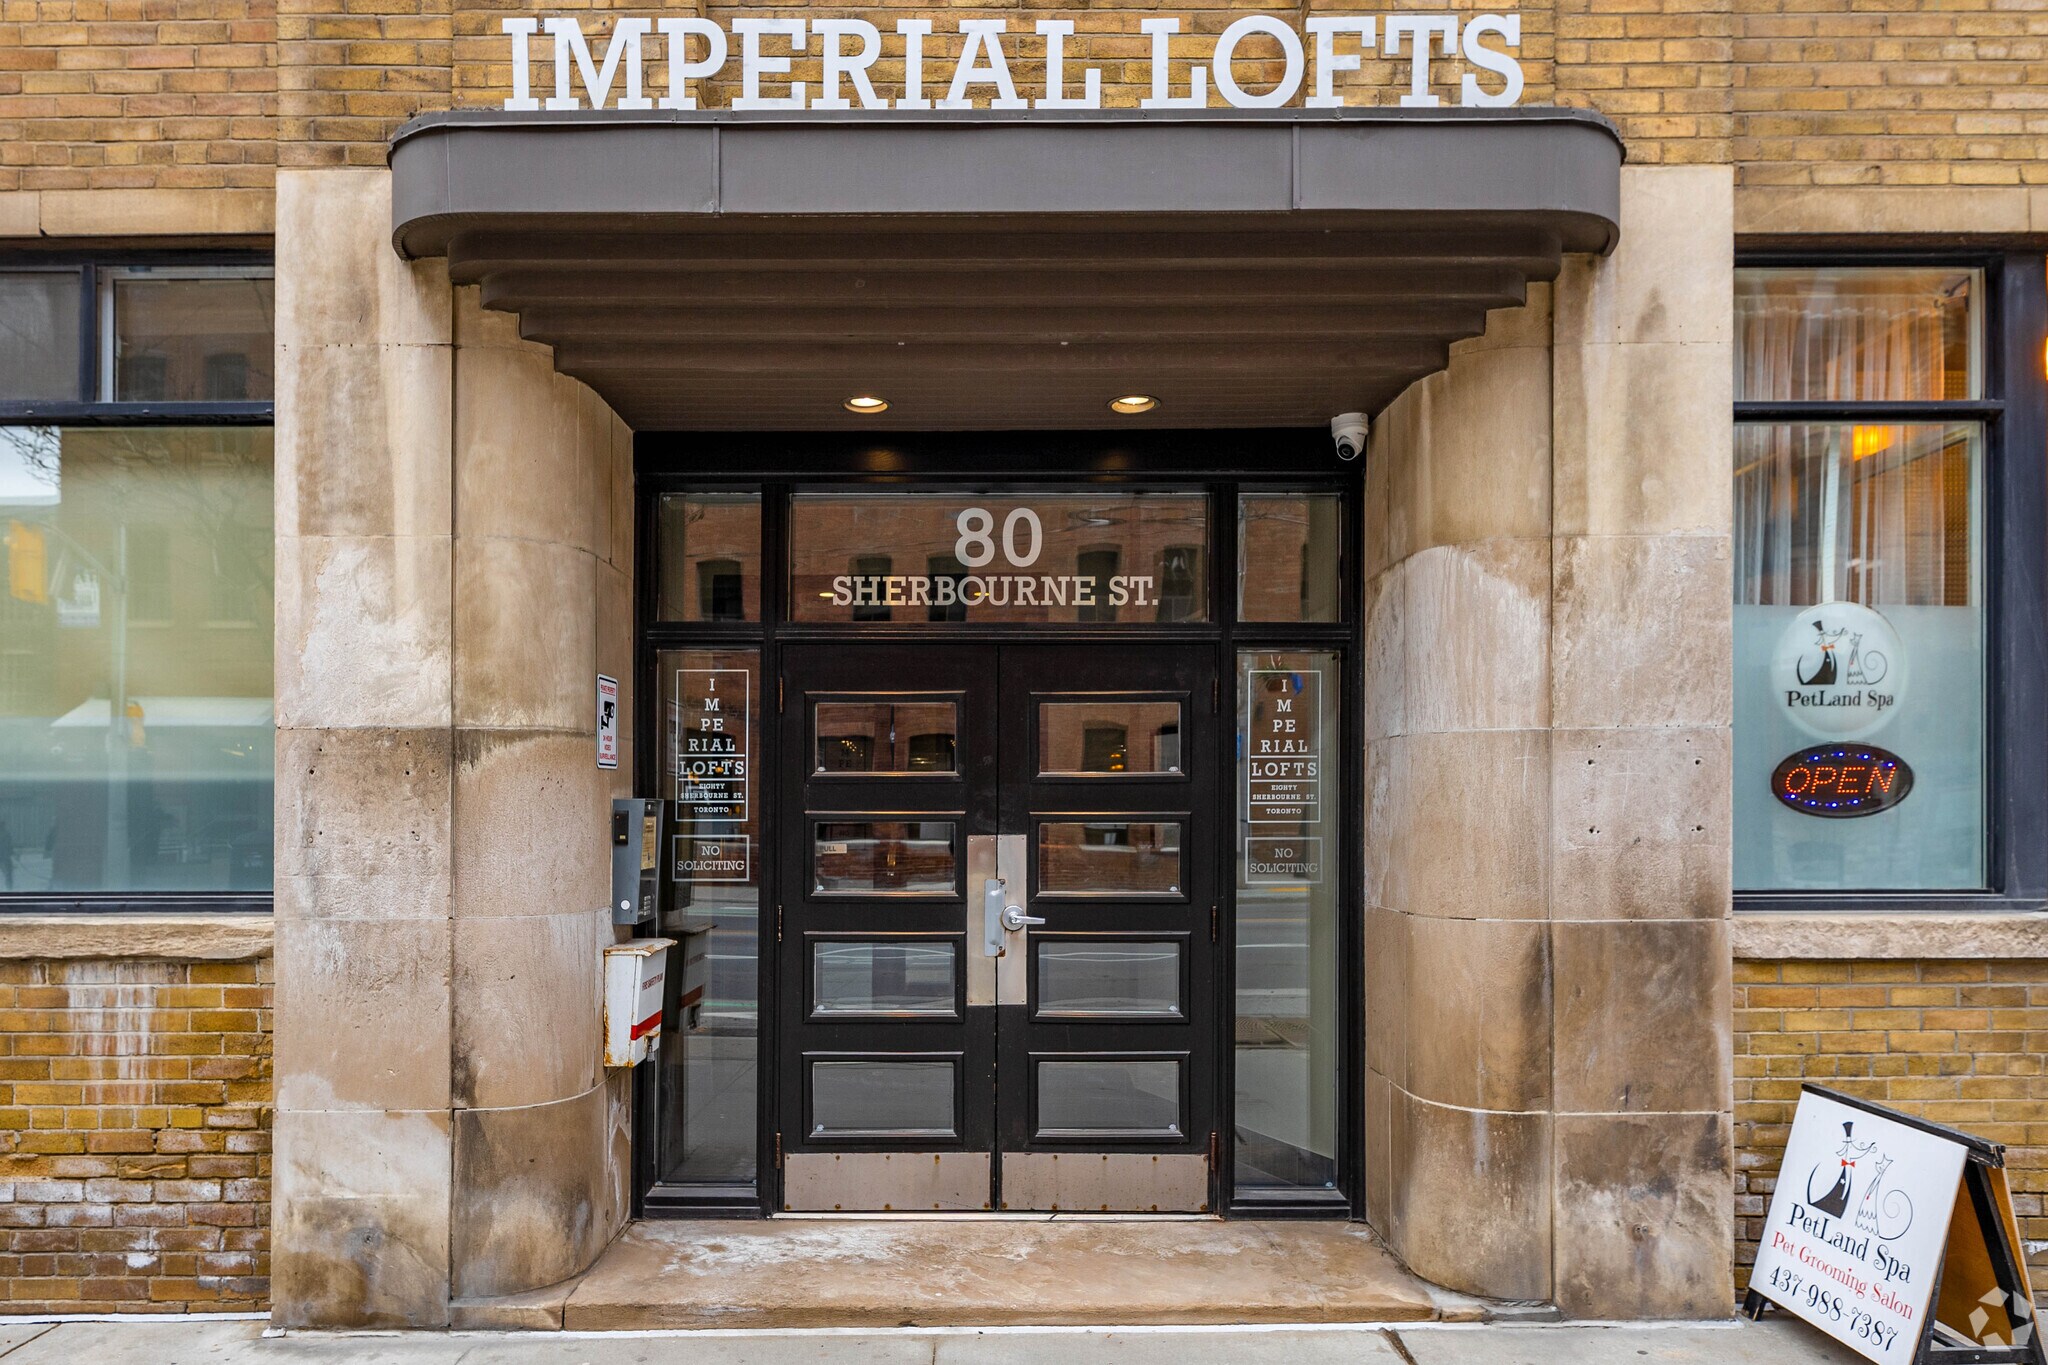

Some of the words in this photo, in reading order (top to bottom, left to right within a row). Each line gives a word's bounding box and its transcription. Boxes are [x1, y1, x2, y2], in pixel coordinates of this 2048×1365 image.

[501, 16, 1102, 111] IMPERIAL
[1140, 14, 1526, 109] LOFTS
[954, 507, 1043, 567] 80
[832, 575, 1096, 606] SHERBOURNE
[1108, 575, 1159, 606] ST.
[704, 698, 719, 711] M
[1276, 699, 1292, 712] M
[1785, 690, 1861, 708] PetLand
[1867, 690, 1894, 710] Spa
[700, 718, 723, 731] PE
[1272, 719, 1296, 732] PE
[688, 738, 736, 752] RIAL
[1260, 739, 1308, 753] RIAL
[679, 761, 744, 775] LOFTS
[1251, 762, 1317, 776] LOFTS
[1785, 766, 1896, 793] OPEN
[701, 846, 720, 856] NO
[1274, 848, 1293, 858] NO
[677, 860, 745, 871] SOLICITING
[1250, 863, 1318, 873] SOLICITING
[1786, 1202, 1869, 1261] PetLand
[1873, 1244, 1911, 1284] Spa
[1771, 1231, 1794, 1257] Pet
[1799, 1246, 1868, 1298] Grooming
[1873, 1283, 1913, 1319] Salon
[1770, 1265, 1899, 1351] 437-988-7387
